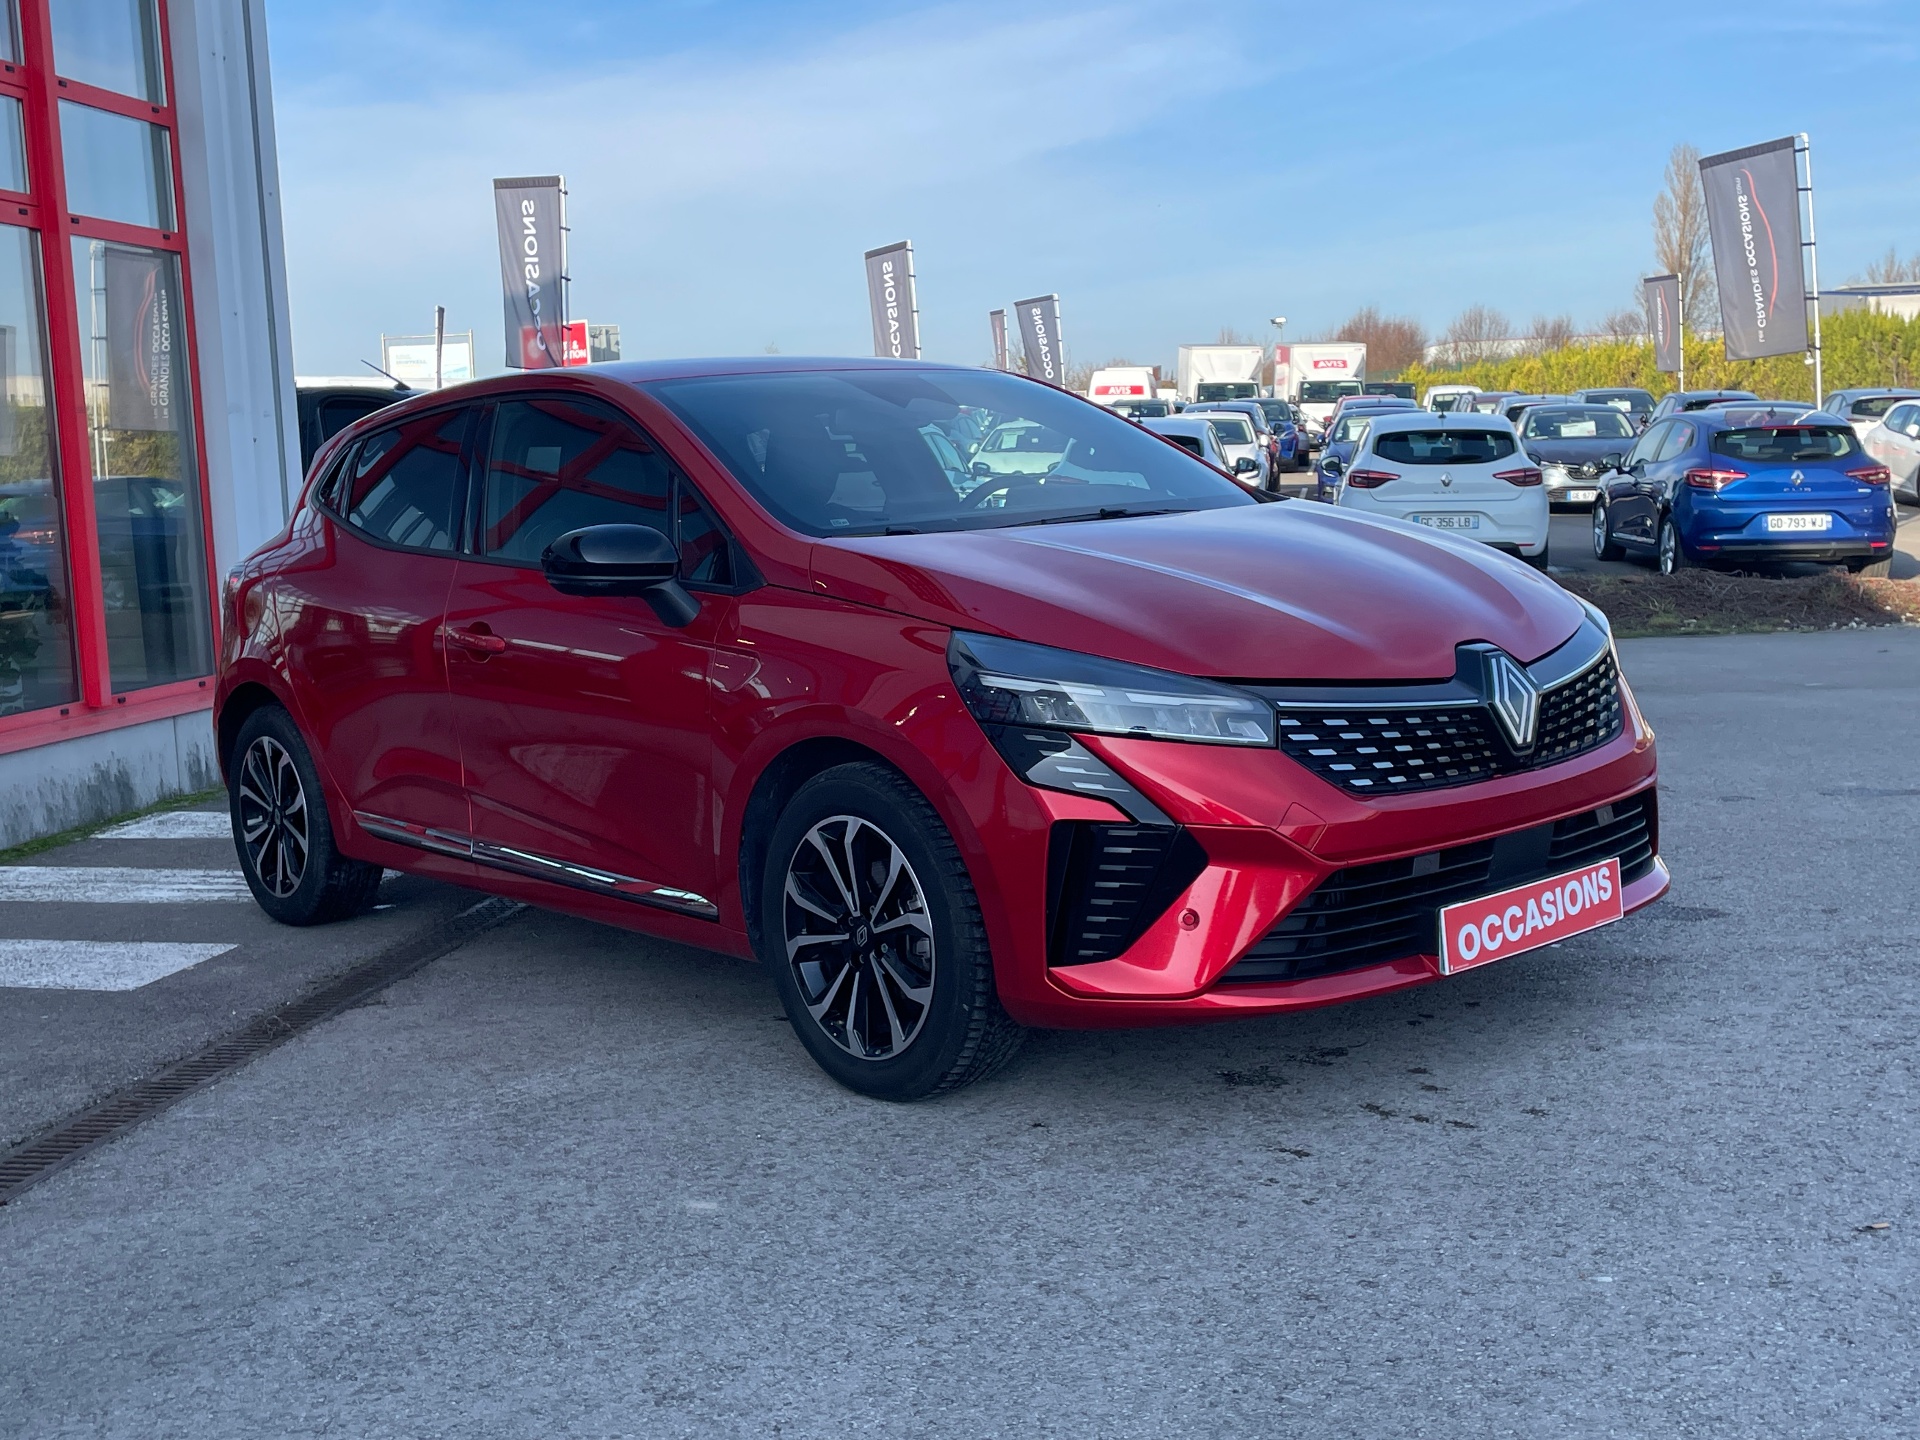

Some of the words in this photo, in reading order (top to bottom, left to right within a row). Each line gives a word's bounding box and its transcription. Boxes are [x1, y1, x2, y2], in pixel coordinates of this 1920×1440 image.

[1317, 360, 1345, 368] AVIS
[159, 354, 170, 406] GRANDES
[1108, 386, 1132, 395] AVIS
[1457, 866, 1613, 961] OCCASIONS
